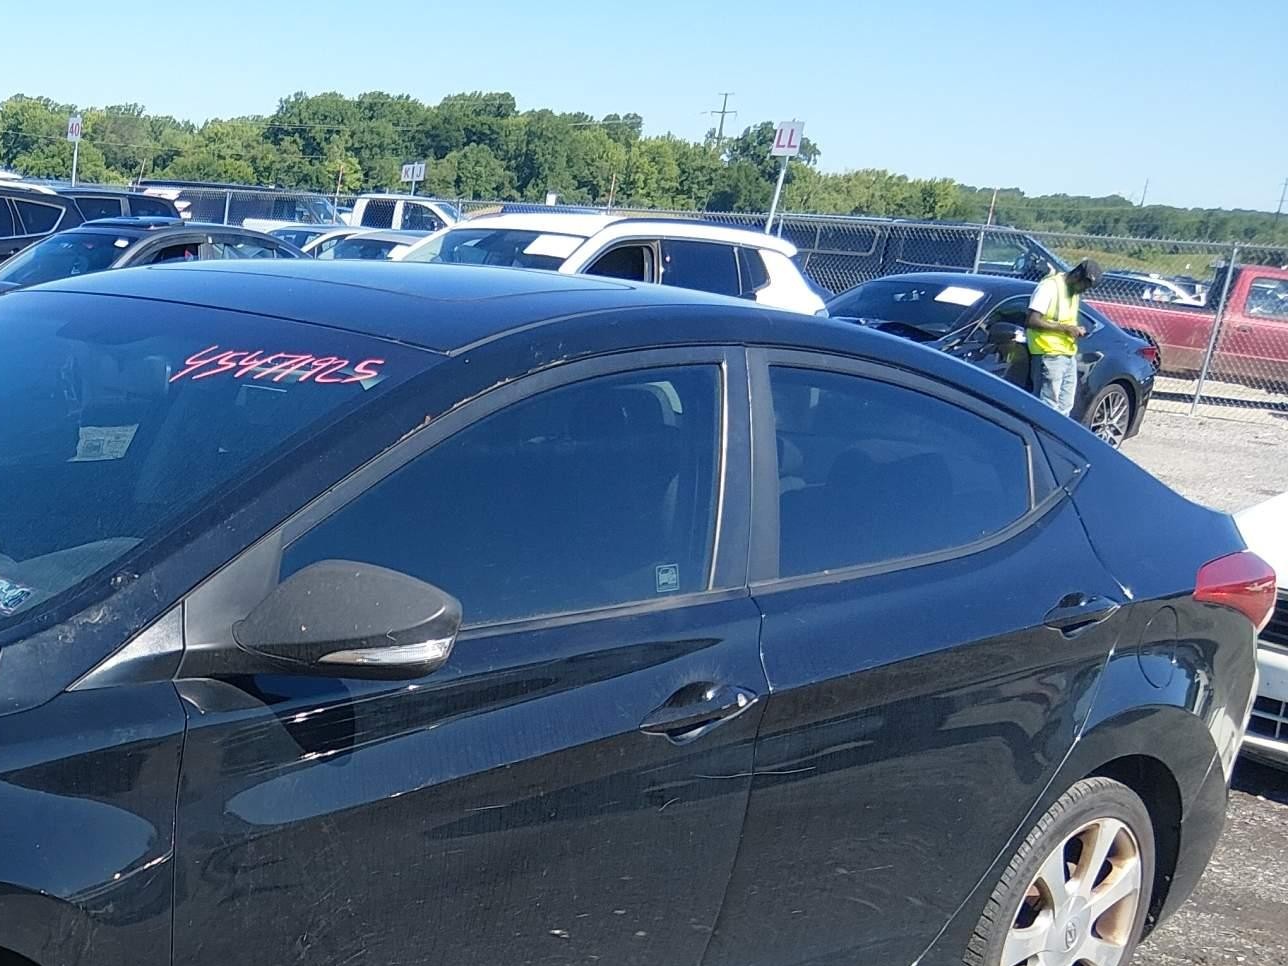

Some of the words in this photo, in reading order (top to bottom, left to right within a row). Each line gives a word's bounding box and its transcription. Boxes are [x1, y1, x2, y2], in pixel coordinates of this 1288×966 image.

[69, 122, 80, 137] 40
[775, 128, 798, 149] LL
[169, 345, 385, 383] 45471925
